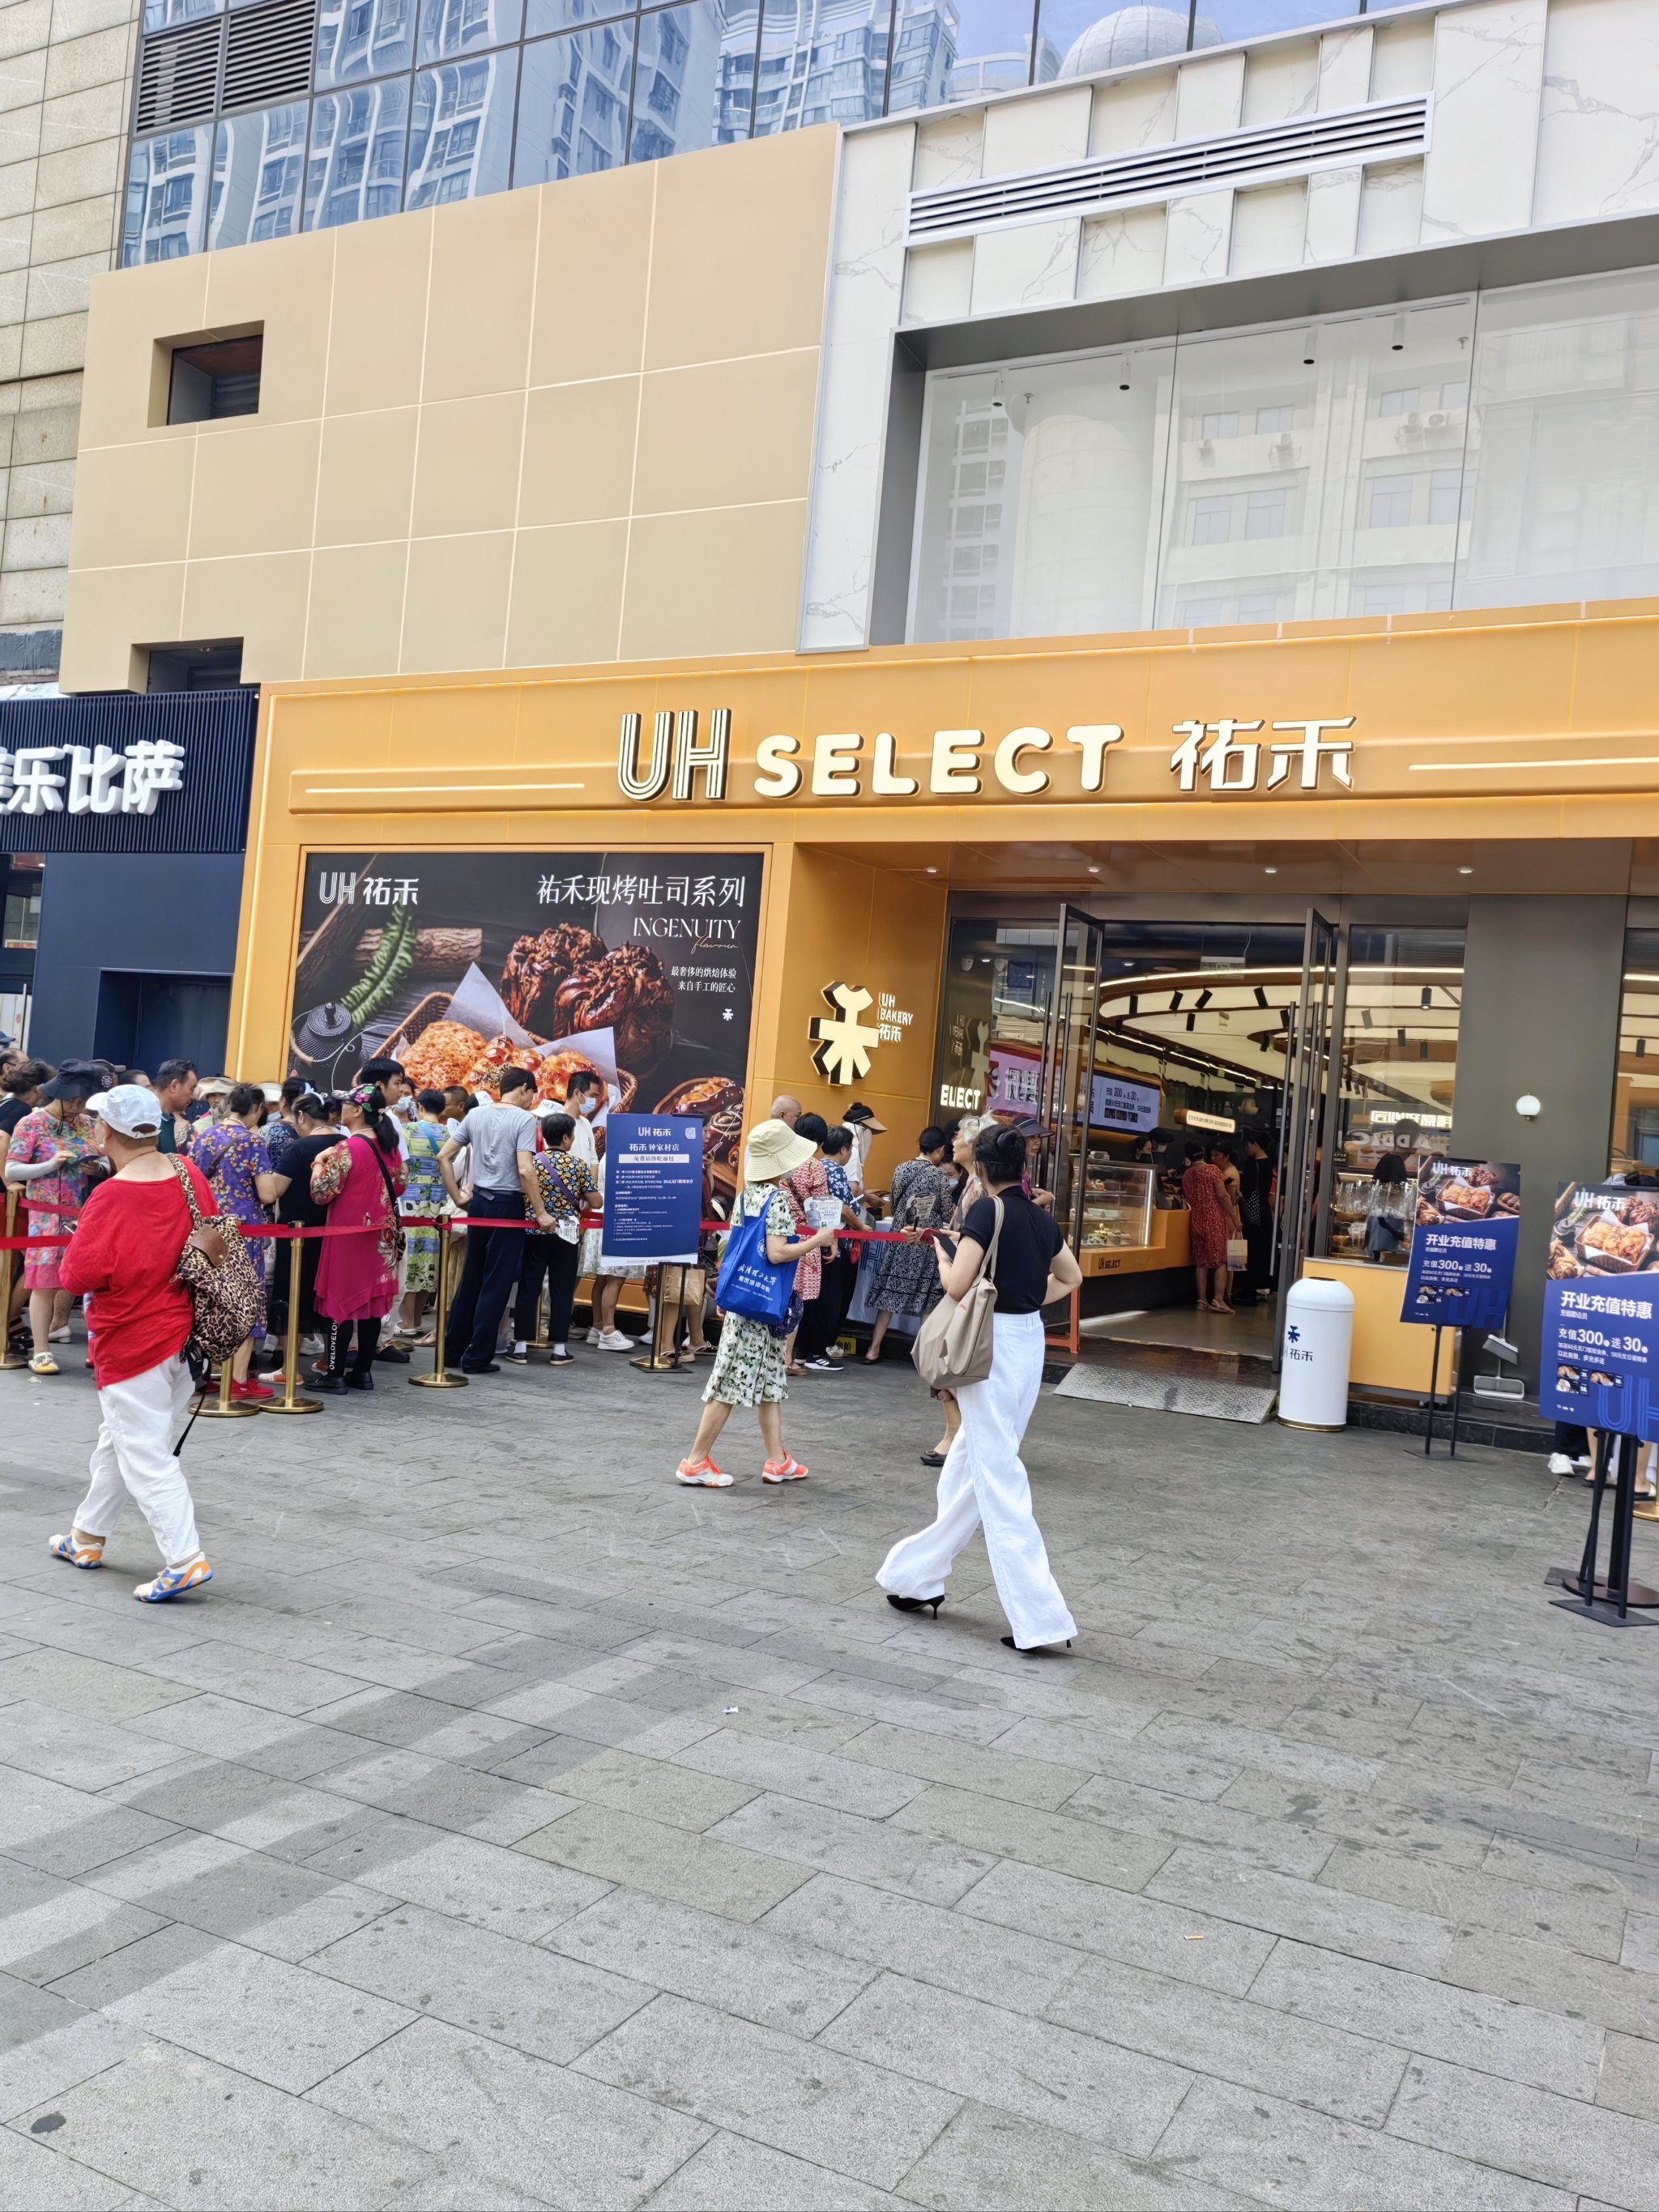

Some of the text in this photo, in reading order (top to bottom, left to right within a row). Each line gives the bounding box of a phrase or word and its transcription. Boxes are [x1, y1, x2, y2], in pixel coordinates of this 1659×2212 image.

[617, 708, 1125, 802] UH SELECT
[1170, 716, 1357, 792] 祐禾
[319, 872, 420, 906] UH 祐禾
[536, 874, 746, 908] 祐禾现烤吐司系列
[633, 917, 741, 940] INGENUITY
[671, 965, 737, 979] 最奢侈的烘焙体验
[677, 980, 736, 993] 来自手工的匠心
[881, 992, 895, 1008] UH
[879, 1008, 913, 1025] BAKERY
[879, 1023, 902, 1042] 祐禾
[638, 1127, 672, 1137] UH 祐禾
[1432, 1161, 1448, 1175] UH
[1574, 1189, 1595, 1208] UH
[1426, 1234, 1498, 1251] 开业充值特惠
[1560, 1290, 1653, 1319] 开业充值特惠
[1290, 1348, 1314, 1362] 祐禾
